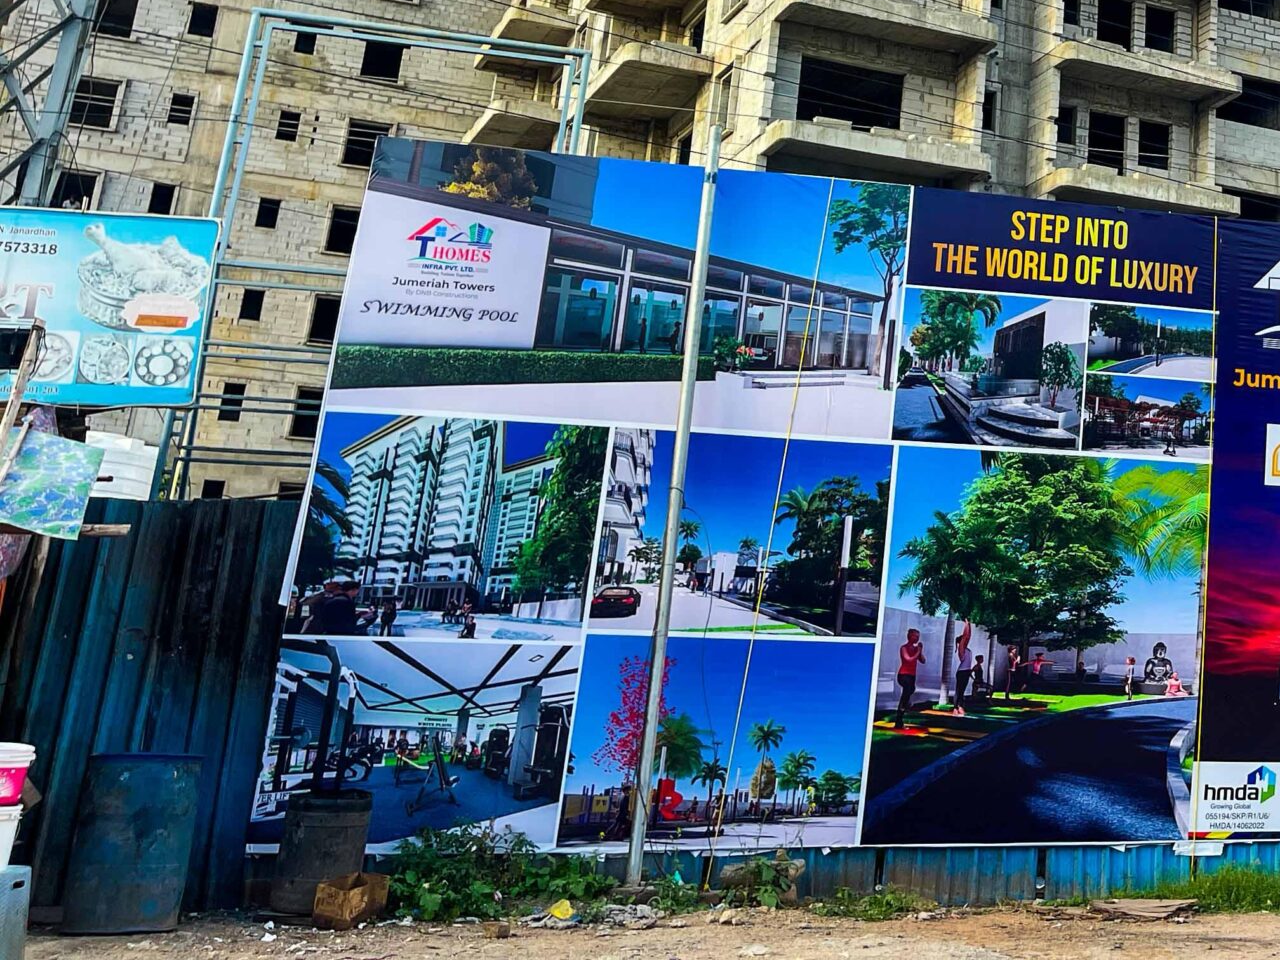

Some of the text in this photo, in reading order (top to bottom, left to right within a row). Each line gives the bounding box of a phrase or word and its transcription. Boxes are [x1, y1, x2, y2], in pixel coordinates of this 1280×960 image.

[10, 226, 56, 237] Janardhan
[1010, 210, 1129, 250] STEP INTO
[432, 246, 491, 263] HOMES
[932, 242, 1199, 295] THE WORLD OF LUXURY
[392, 276, 495, 293] Jumeriah Towers
[415, 289, 432, 297] DNB
[360, 300, 520, 323] SWIMMING POOL
[1204, 784, 1259, 800] hmda
